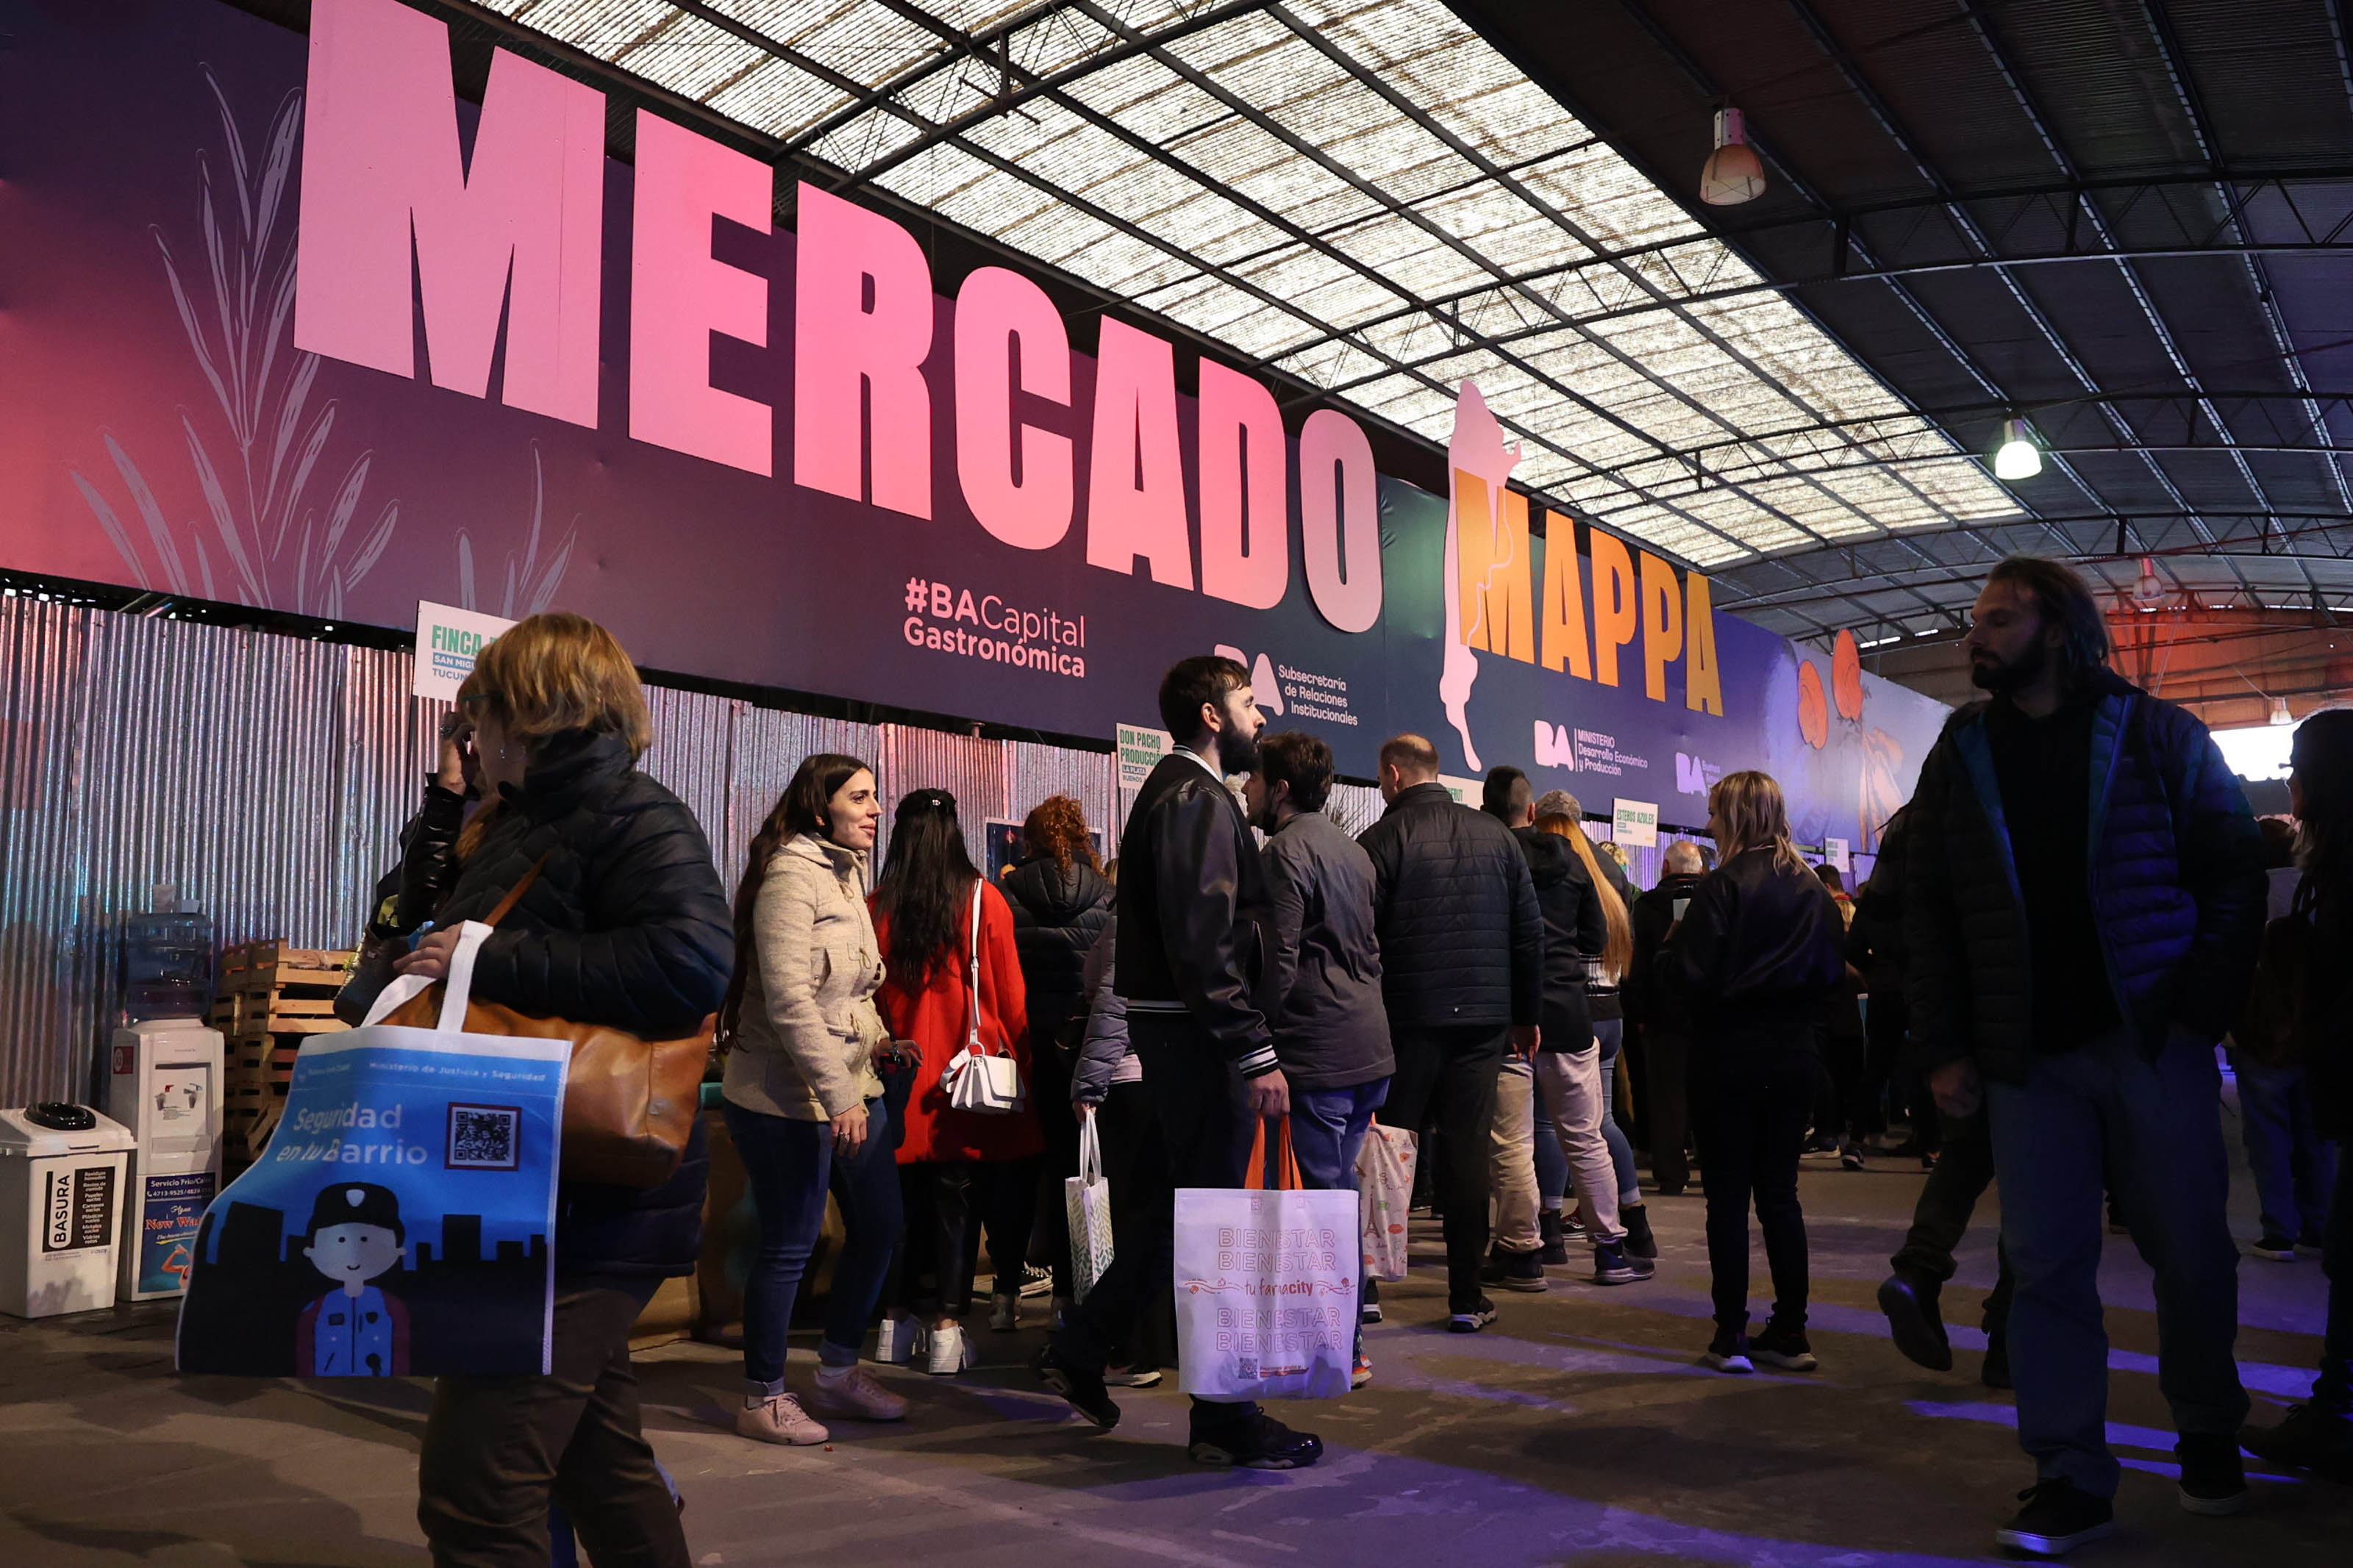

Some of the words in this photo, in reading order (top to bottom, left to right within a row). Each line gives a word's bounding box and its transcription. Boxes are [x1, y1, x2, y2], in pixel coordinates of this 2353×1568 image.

[293, 0, 1382, 634] MERCADO
[1454, 467, 1724, 717] MAPPA
[432, 625, 482, 656] FINCA
[904, 616, 1085, 679] Gastronómica
[434, 654, 454, 666] SAN
[1278, 664, 1347, 692] Subsecretaría
[1285, 683, 1297, 698] de
[1299, 684, 1348, 708] Relaciones
[1290, 701, 1359, 726] Institucionales
[1119, 728, 1135, 746] DON
[1136, 731, 1161, 750] PACHO
[1577, 728, 1615, 749] MINISTERIO
[1121, 747, 1165, 767] PRODUCCIÓ
[1578, 743, 1613, 762] Desarrollo
[1614, 751, 1649, 769] Económico
[1579, 759, 1584, 772] y
[1585, 758, 1622, 777] Producción
[1617, 809, 1636, 823] ESTEROS
[1637, 812, 1654, 825] AZULES
[421, 1064, 436, 1073] de
[492, 1070, 546, 1081] Seguridad
[294, 1102, 402, 1134] Seguridad
[276, 1145, 301, 1162] en
[304, 1141, 323, 1161] tu
[322, 1139, 427, 1165] Barrio
[151, 1180, 180, 1188] Servicio
[54, 1175, 71, 1243] BASURA
[1218, 1228, 1335, 1249] BIENESTAR
[1218, 1251, 1337, 1272] BIENESTAR
[1260, 1278, 1313, 1296] faracity
[1217, 1306, 1340, 1329] BIENESTAR
[1216, 1330, 1343, 1353] BIENESTAR
